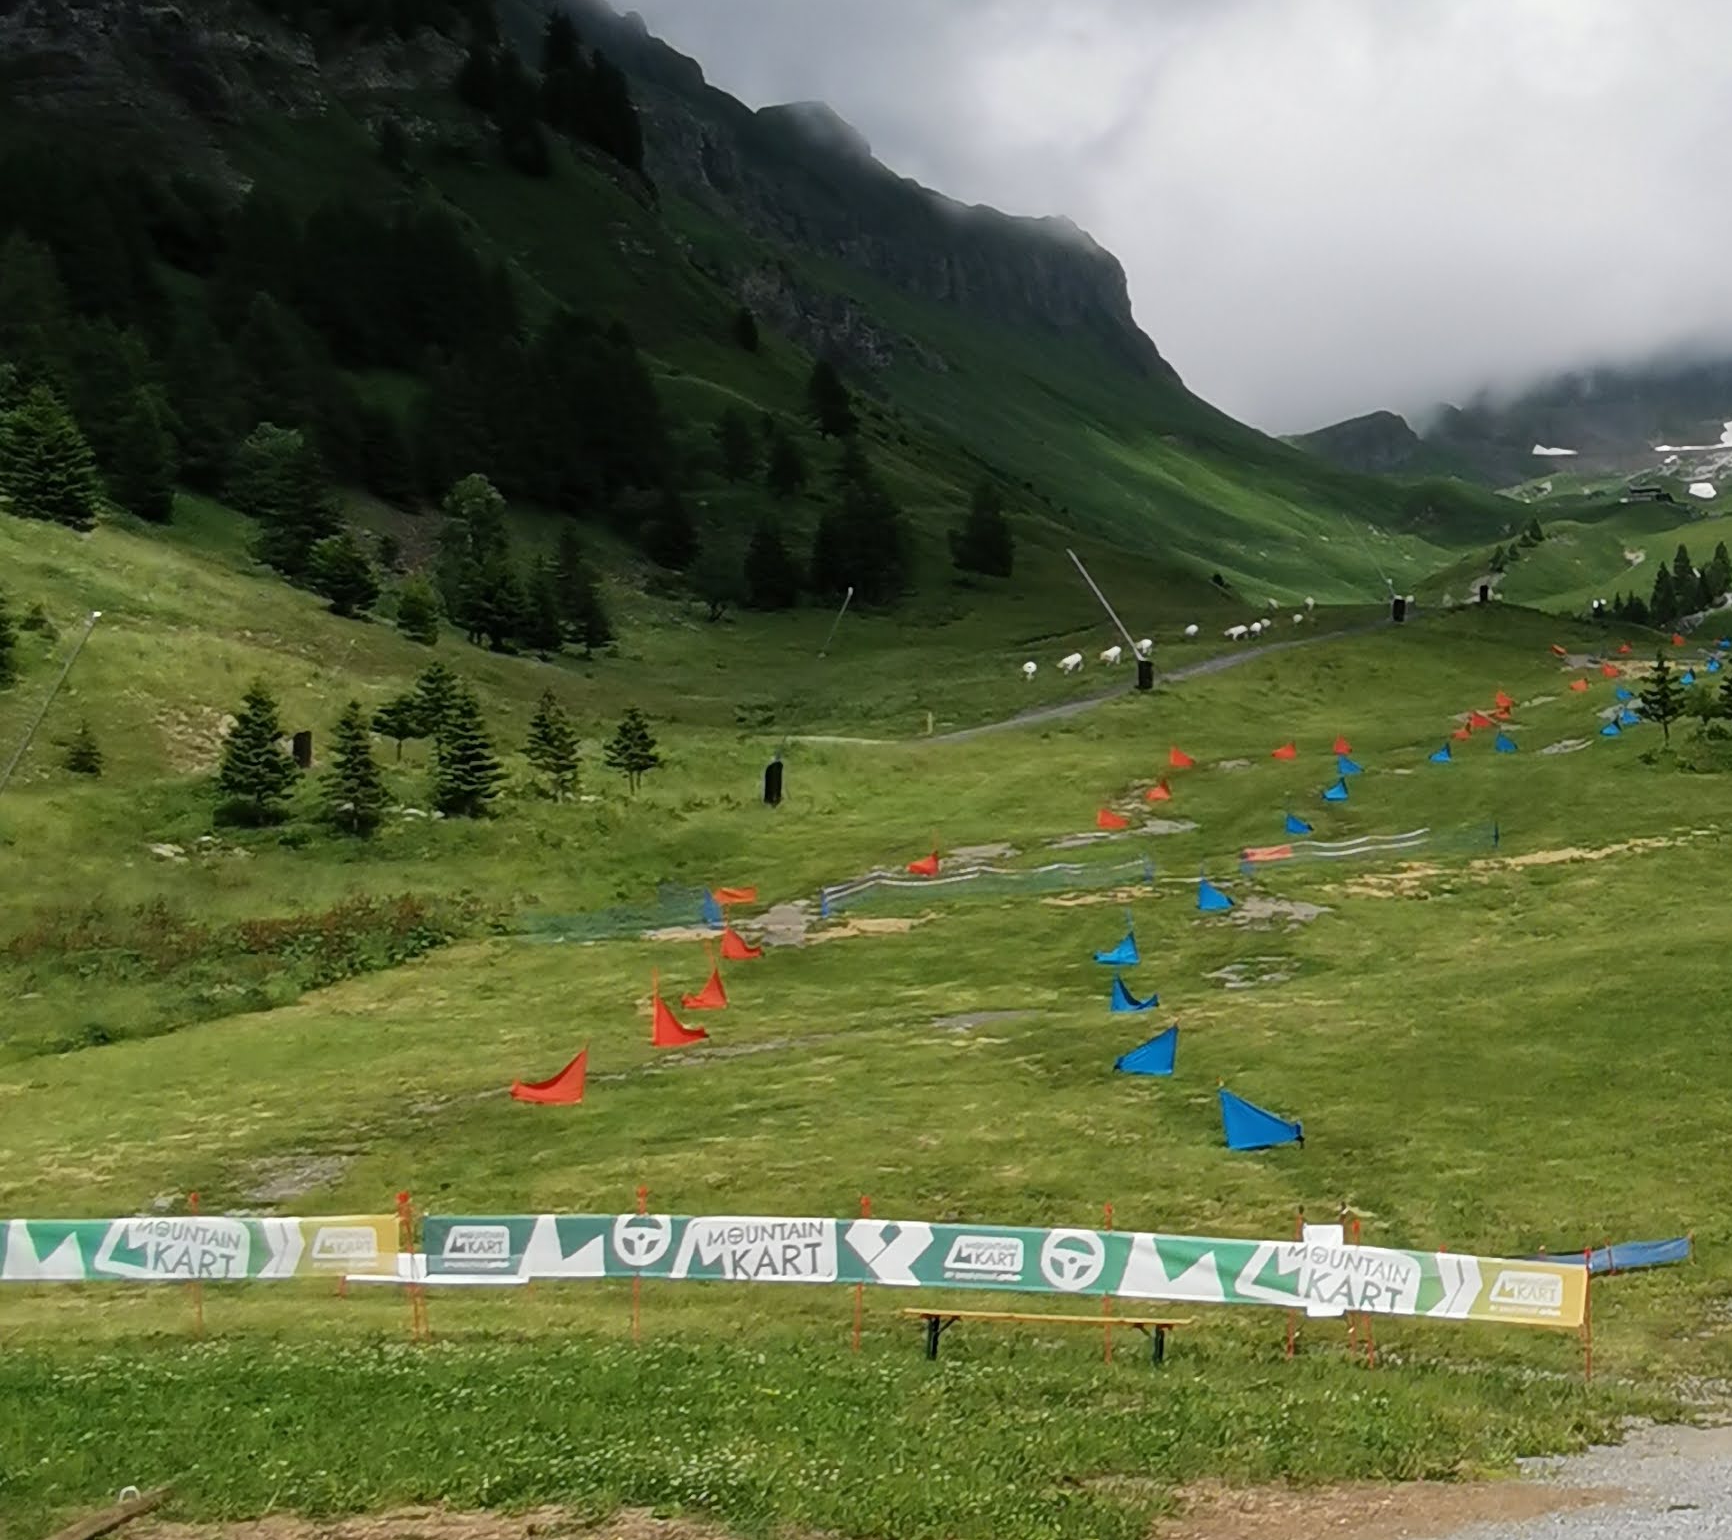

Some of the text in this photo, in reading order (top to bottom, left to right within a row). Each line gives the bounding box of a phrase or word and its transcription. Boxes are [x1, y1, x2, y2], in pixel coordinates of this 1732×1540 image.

[136, 1221, 240, 1251] MOUNTAIN
[707, 1221, 824, 1246] MOUNTAIN
[151, 1241, 236, 1277] KART
[732, 1243, 823, 1278] KART
[974, 1250, 1017, 1267] KART
[1287, 1244, 1412, 1285] MOUNTAIN
[1304, 1268, 1405, 1311] KART
[1516, 1283, 1557, 1302] KART
